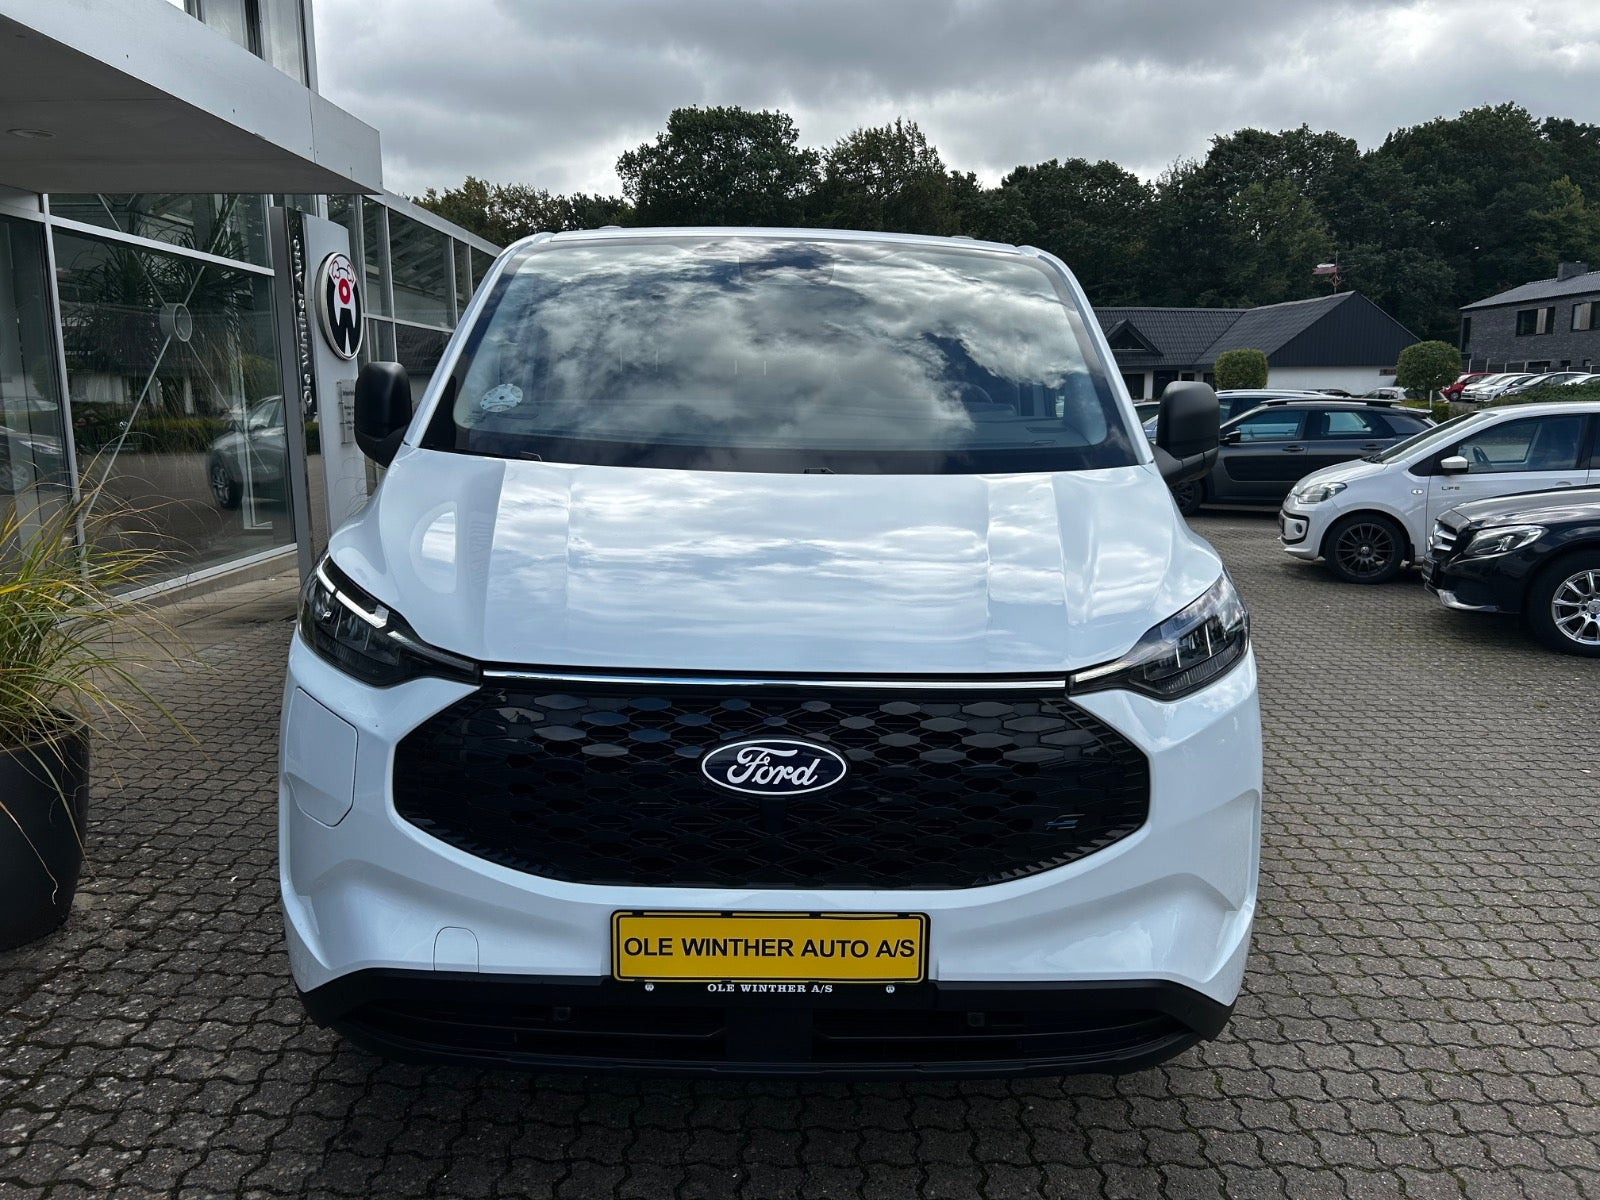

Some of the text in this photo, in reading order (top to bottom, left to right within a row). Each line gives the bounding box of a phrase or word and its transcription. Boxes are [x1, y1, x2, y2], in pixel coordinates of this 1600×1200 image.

[727, 746, 821, 785] Ford
[623, 937, 915, 958] OLE WINTHER AUTO A/S
[707, 983, 833, 994] OLE WINTHER A/S
